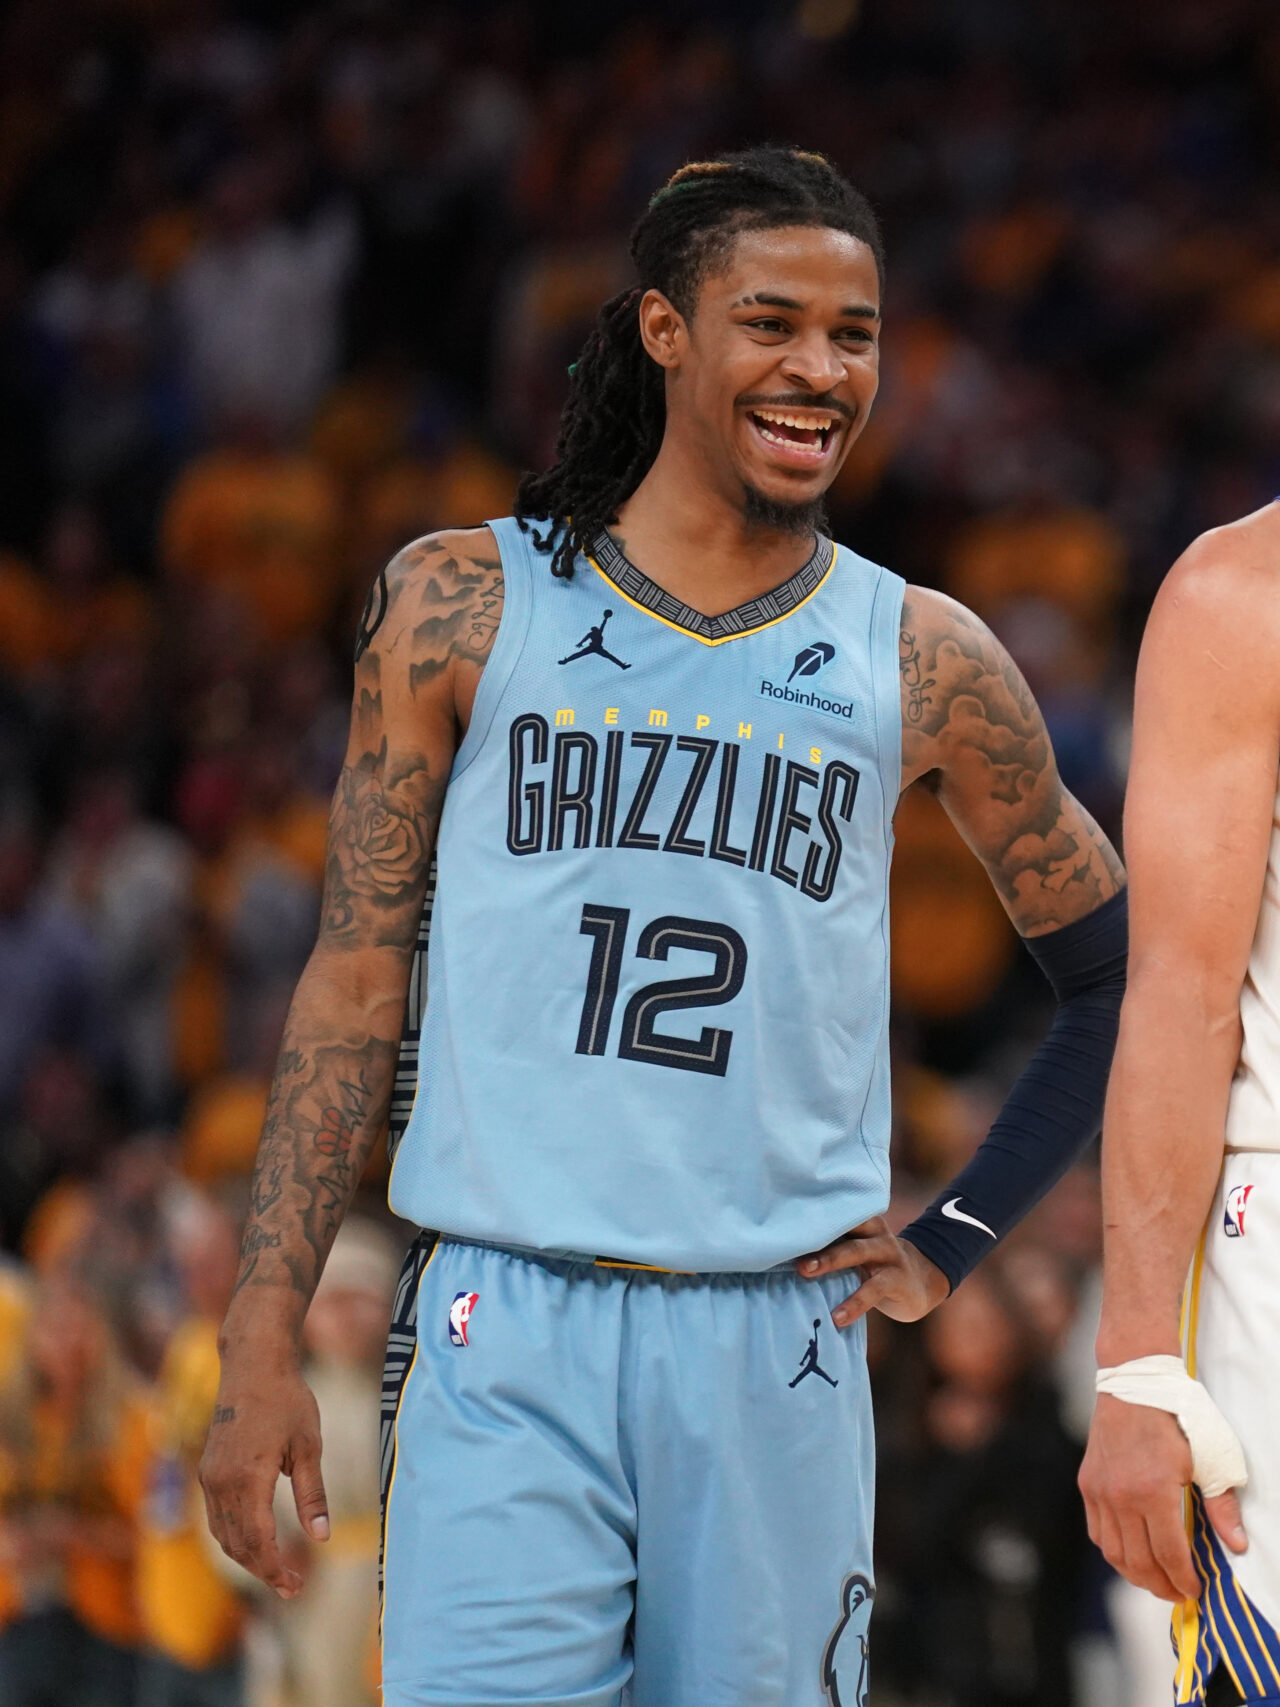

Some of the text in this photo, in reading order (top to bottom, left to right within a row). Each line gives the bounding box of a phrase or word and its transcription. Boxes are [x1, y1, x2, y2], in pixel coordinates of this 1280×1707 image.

[555, 707, 823, 765] MEMPHIS
[760, 680, 854, 719] Robinhood
[506, 712, 861, 903] GRIZZLIES
[574, 903, 748, 1077] 12
